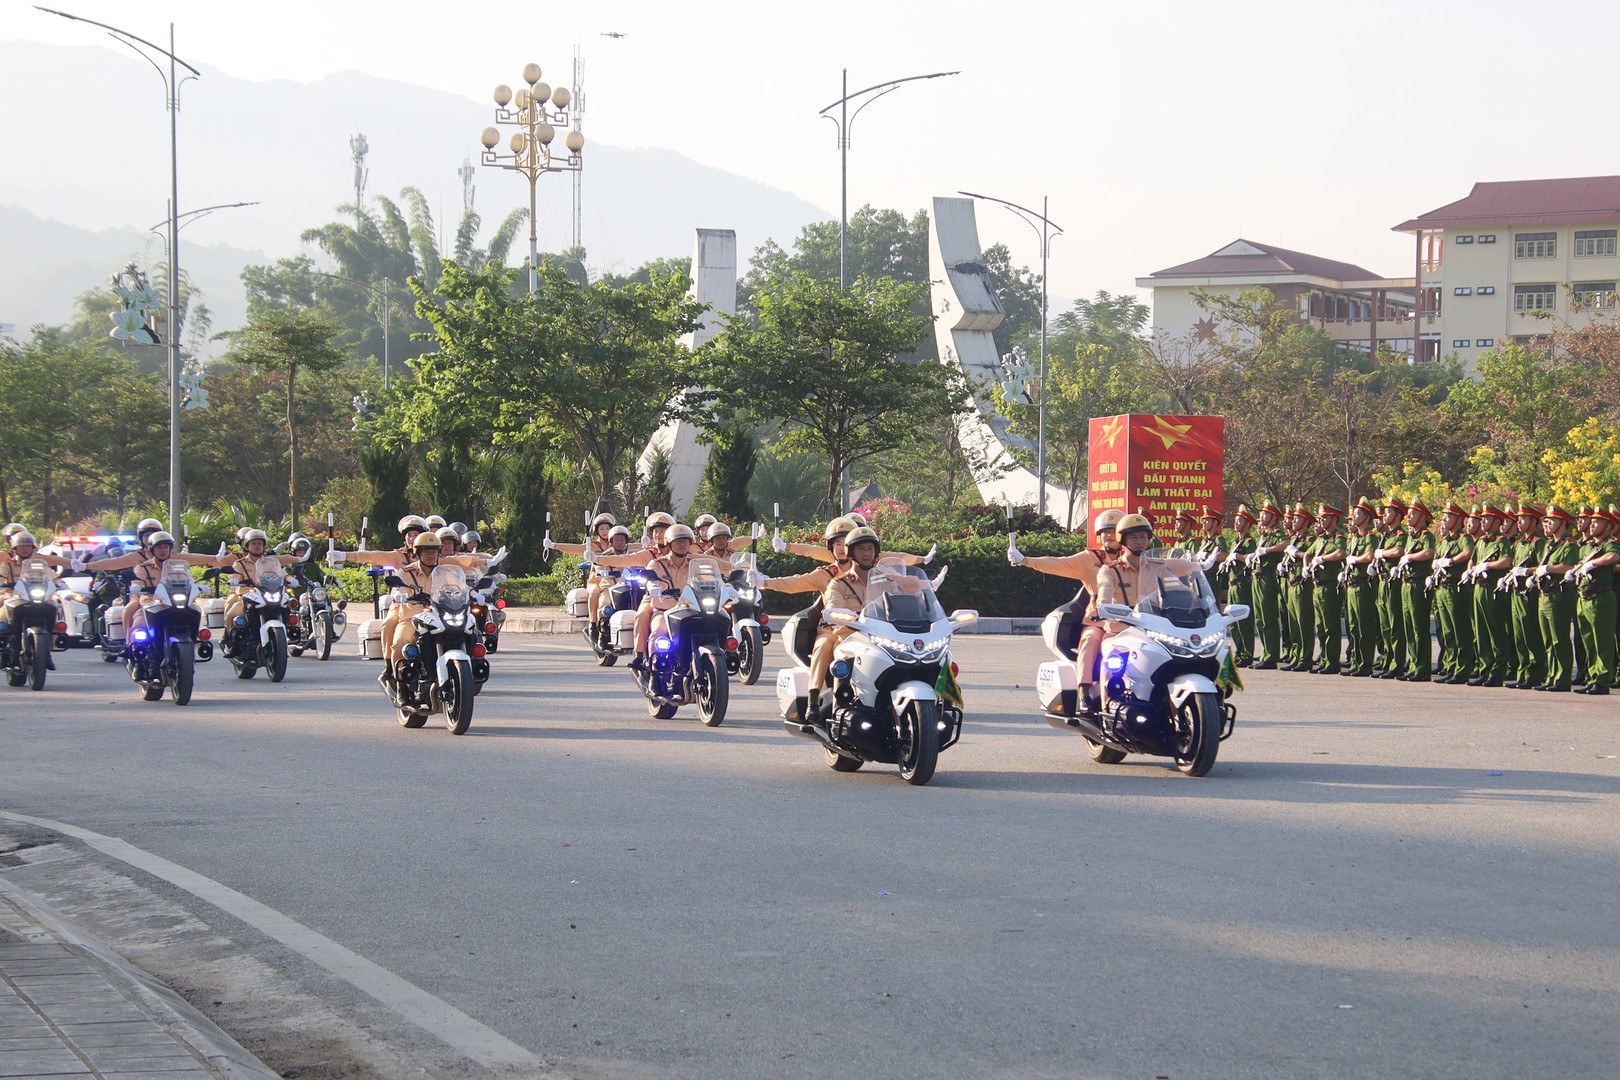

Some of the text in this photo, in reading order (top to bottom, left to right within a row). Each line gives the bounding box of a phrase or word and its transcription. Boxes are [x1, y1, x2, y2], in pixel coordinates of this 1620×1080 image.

[1143, 459, 1207, 471] KIÊN QUYẾT
[1143, 472, 1206, 484] ĐẤU TRANH
[1136, 486, 1213, 499] LÀM THẤT BẠI
[1149, 500, 1168, 511] ÂM
[1039, 669, 1055, 682] CSGT
